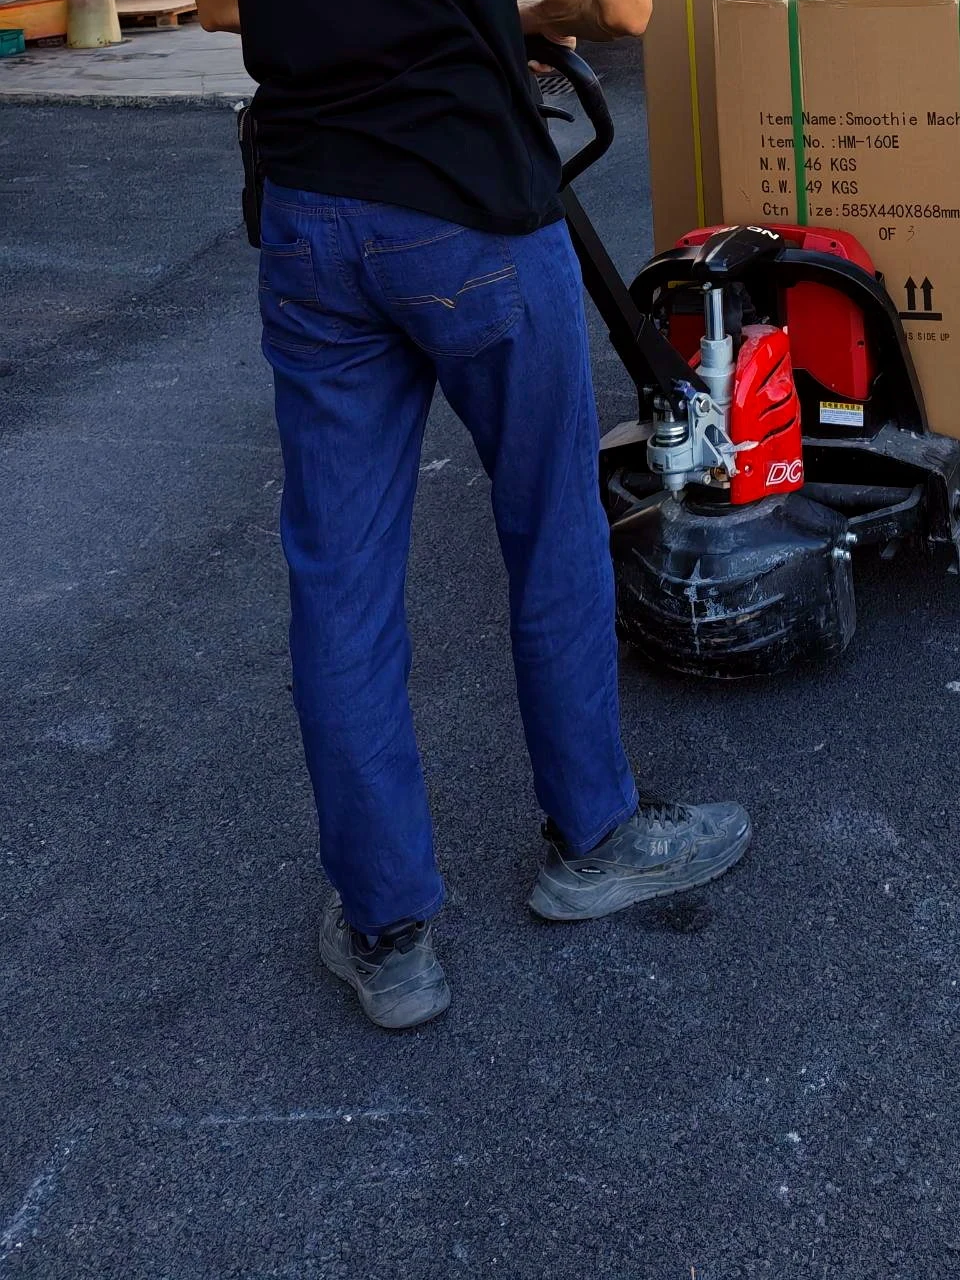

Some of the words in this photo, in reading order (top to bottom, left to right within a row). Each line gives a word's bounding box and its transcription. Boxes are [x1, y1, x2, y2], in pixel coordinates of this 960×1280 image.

[760, 112, 793, 126] Item
[801, 112, 918, 126] Name:Smoothie
[761, 134, 795, 148] Item
[803, 157, 822, 171] 46
[830, 158, 857, 171] KGS
[805, 180, 822, 193] 49
[832, 181, 858, 194] KGS
[762, 202, 789, 216] Ctn
[808, 203, 960, 218] ize:585X440X868mm
[879, 227, 896, 240] OF
[918, 333, 936, 341] SIDE
[940, 333, 950, 341] UP
